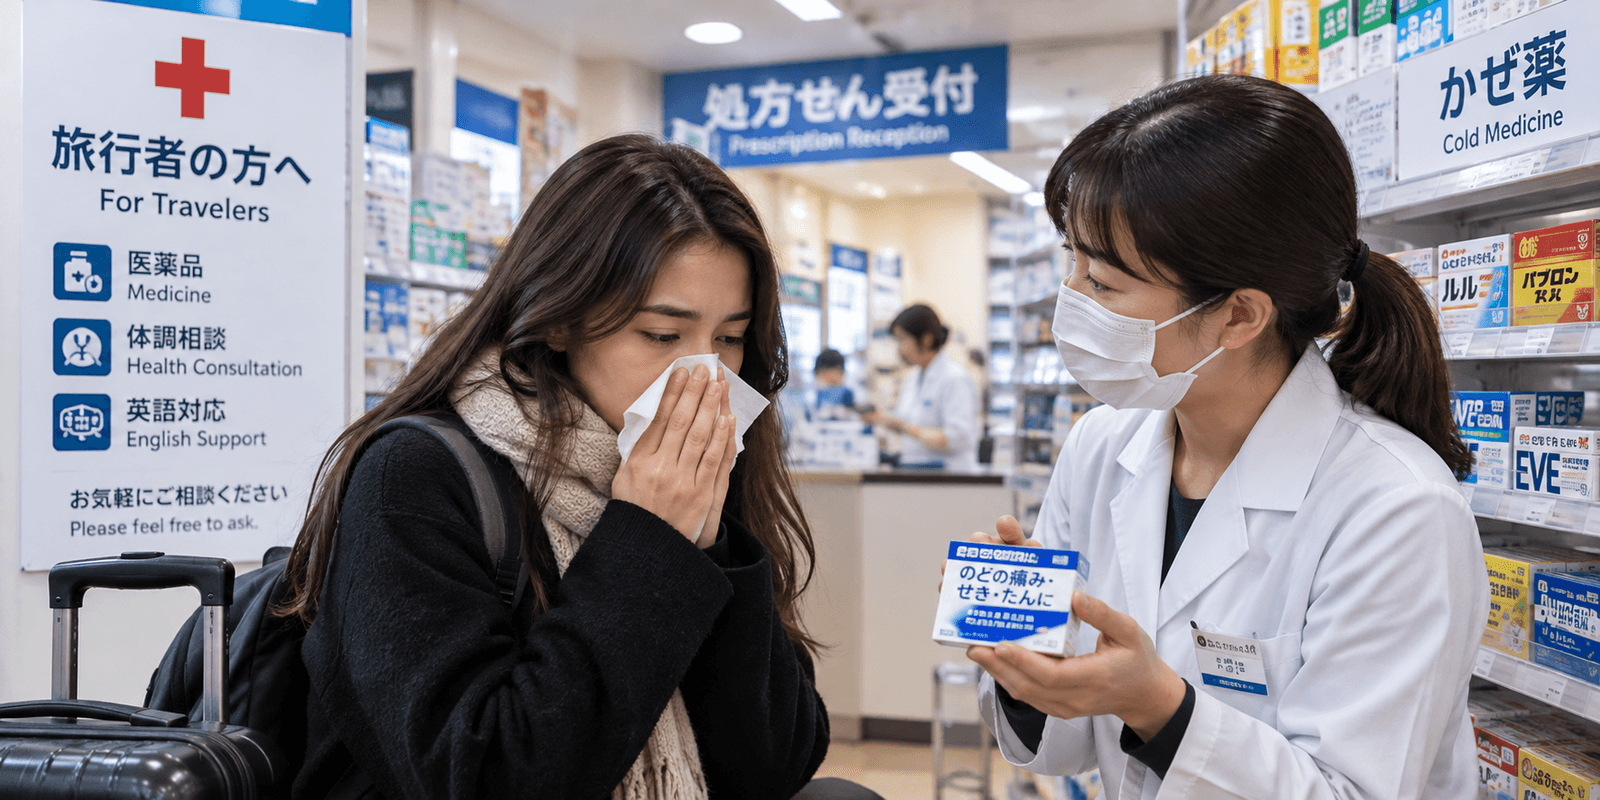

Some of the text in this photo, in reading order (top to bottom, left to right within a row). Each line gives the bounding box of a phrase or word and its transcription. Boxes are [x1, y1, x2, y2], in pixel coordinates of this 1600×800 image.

[1440, 29, 1567, 121] かぜ薬
[703, 63, 979, 130] 処方せん受付
[1443, 108, 1563, 154] Cold Medicine
[51, 125, 312, 187] 旅行者の方へ
[100, 189, 270, 223] For Travelers
[128, 250, 203, 279] 医薬品
[127, 284, 212, 303] Medicine
[1442, 275, 1478, 302] ルル
[126, 324, 226, 351] 体調相談
[127, 358, 303, 377] Health Consultation
[126, 398, 226, 423] 英語対応
[127, 430, 267, 452] English Support
[1516, 450, 1560, 495] EVE
[70, 485, 288, 510] お気軽にご相談ください
[70, 514, 259, 537] Please feel free to ask.
[957, 584, 1054, 607] せき・たんに
